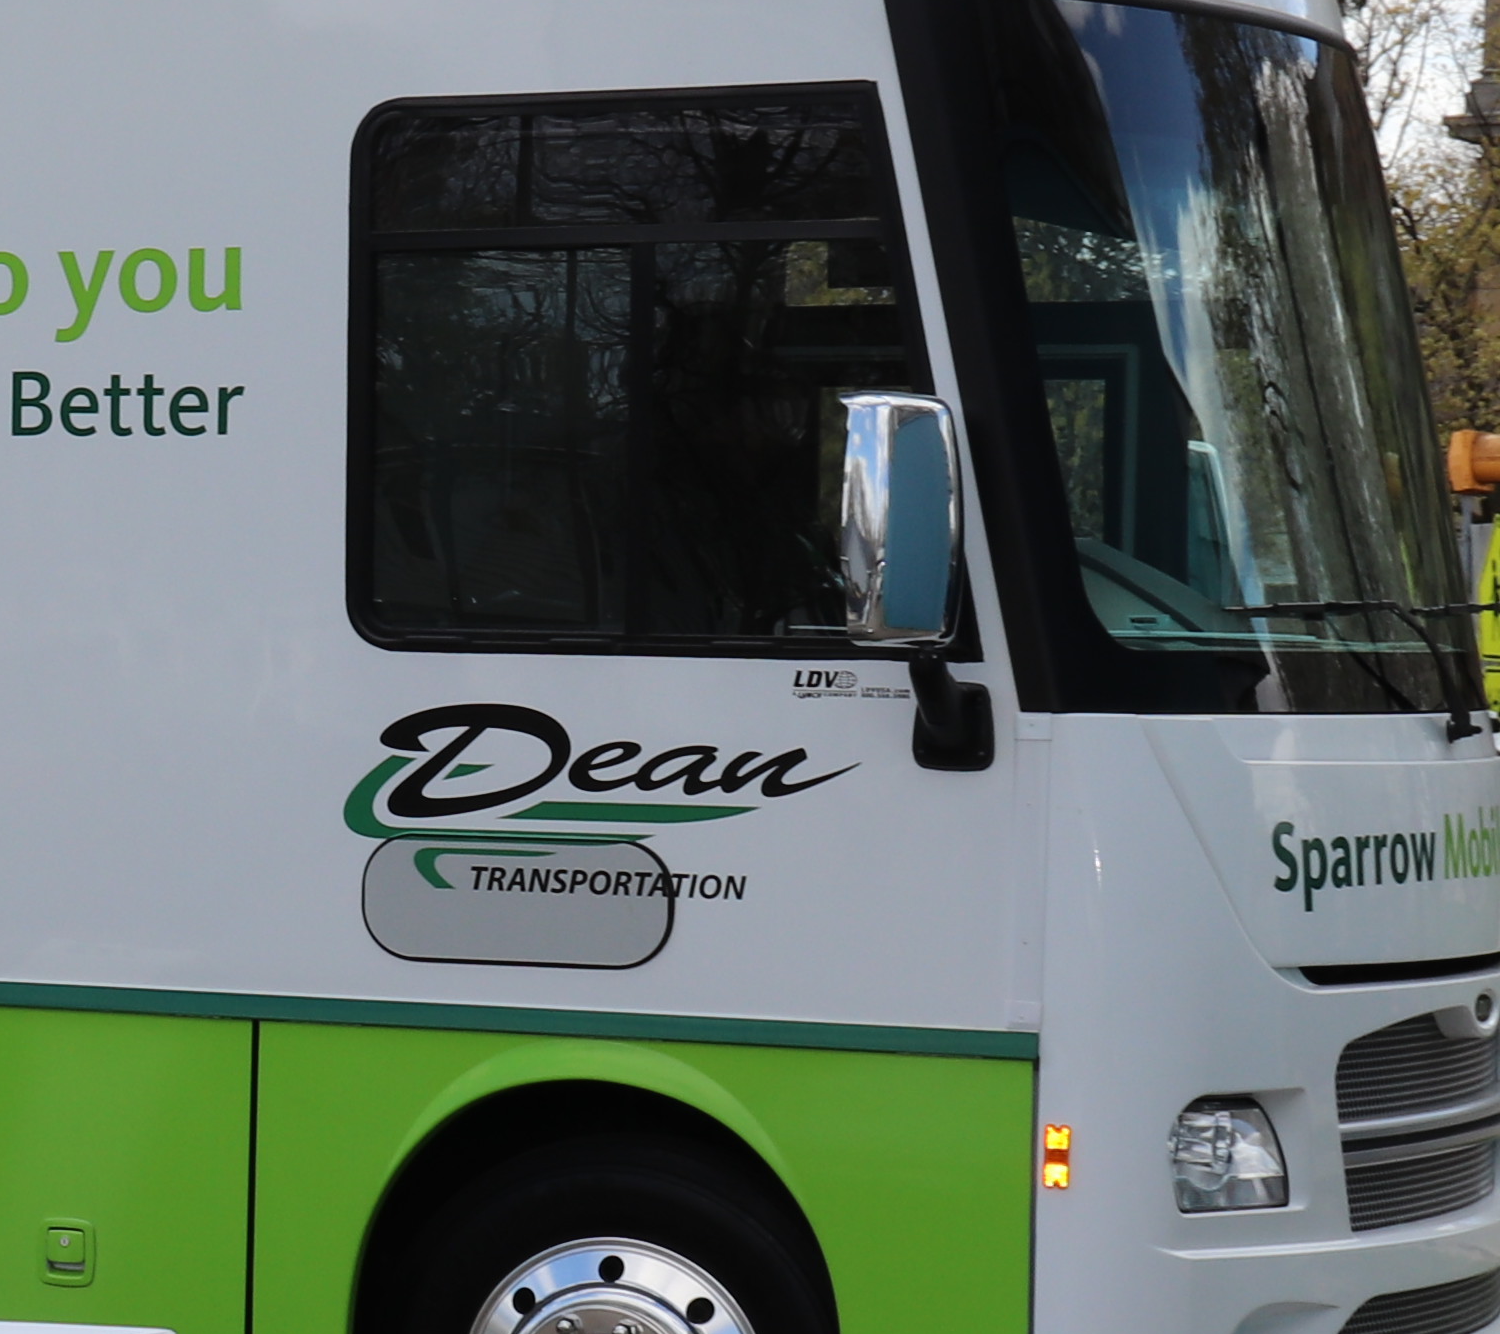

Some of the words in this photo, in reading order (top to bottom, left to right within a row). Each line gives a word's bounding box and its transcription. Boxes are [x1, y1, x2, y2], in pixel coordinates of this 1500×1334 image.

[55, 247, 242, 343] you
[11, 371, 245, 437] Better
[793, 670, 839, 688] LDV
[379, 703, 861, 818] Dean
[470, 865, 747, 901] TRANSPORTATION
[1271, 821, 1437, 912] Sparrow
